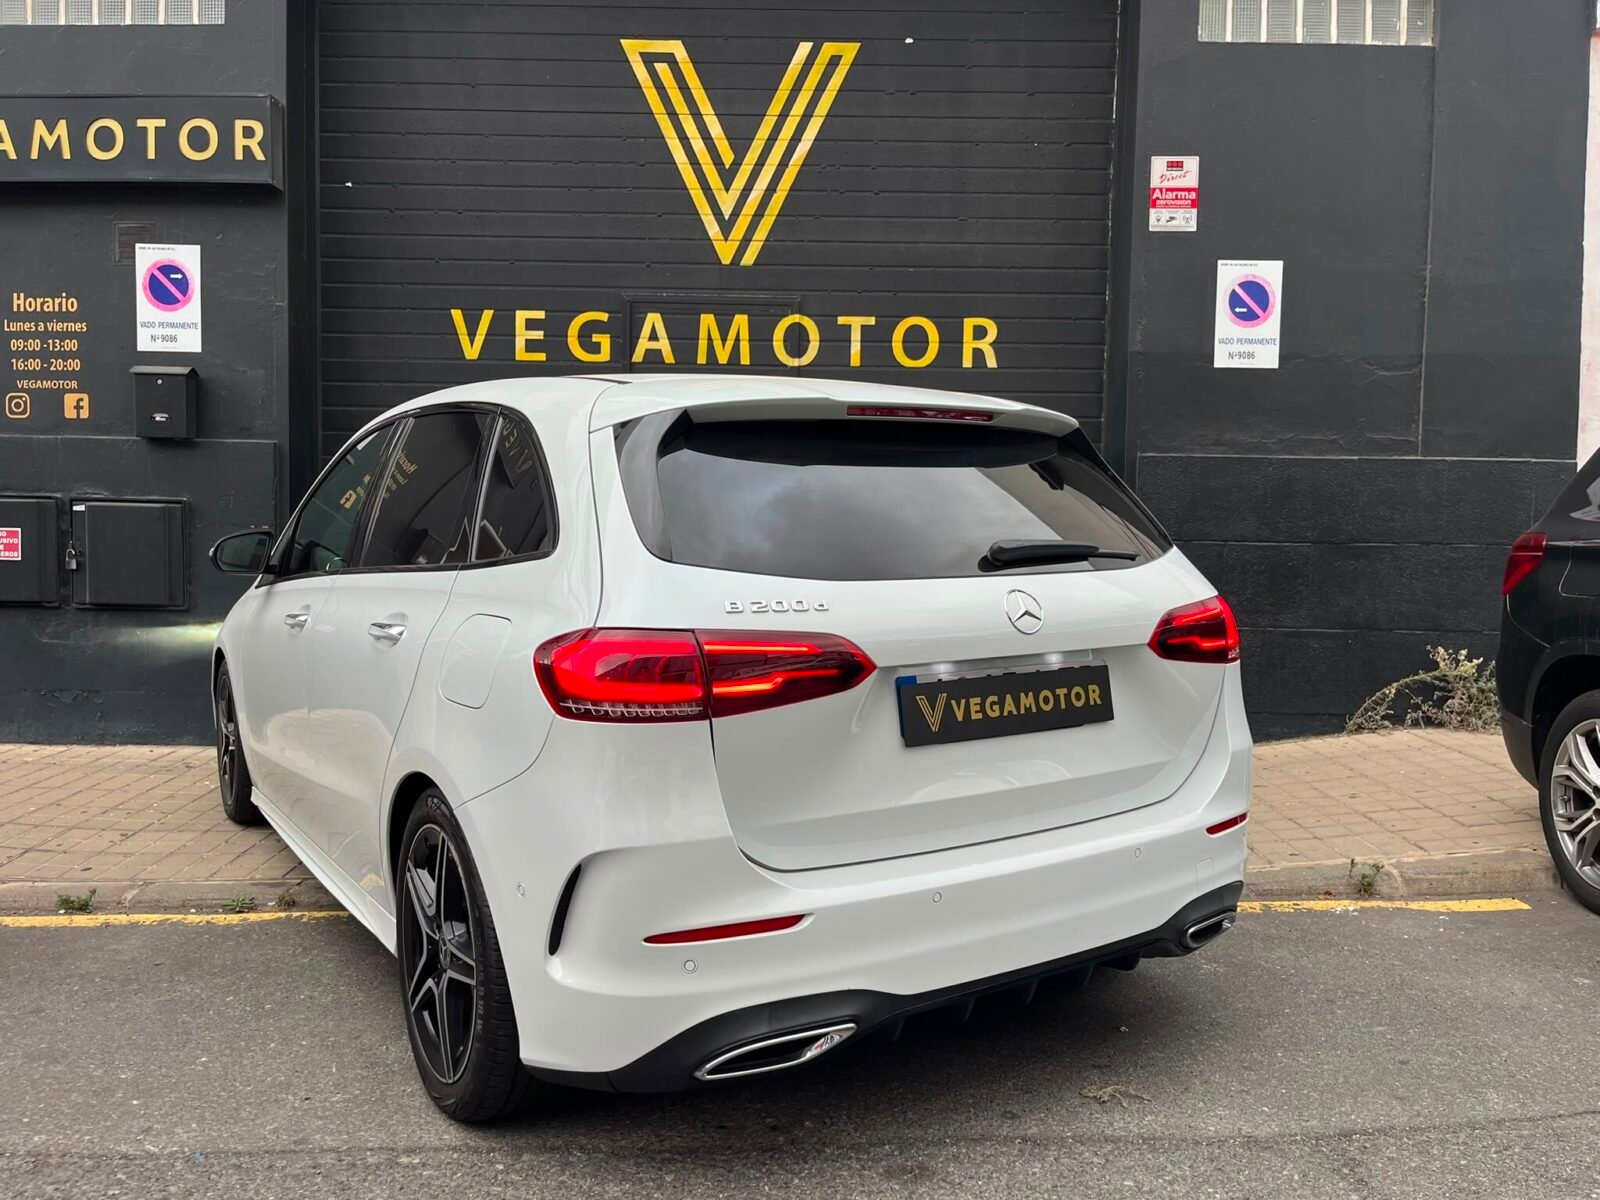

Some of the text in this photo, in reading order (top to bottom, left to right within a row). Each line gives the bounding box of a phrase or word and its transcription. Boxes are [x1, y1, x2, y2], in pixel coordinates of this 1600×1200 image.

[1152, 188, 1196, 200] Alarma
[13, 292, 78, 312] Horario
[4, 319, 87, 332] Lunes a viernes
[140, 321, 199, 330] VADO PERMANENTE
[450, 308, 999, 369] VEGAMOTOR
[1218, 337, 1277, 346] VADO PERMANENTE
[10, 339, 41, 351] 09:00
[11, 359, 41, 371] 16:00
[50, 359, 81, 371] 20:00
[17, 380, 78, 389] VEGAMOTOR
[724, 600, 744, 614] B
[951, 684, 1102, 721] VEGAMOTOR
